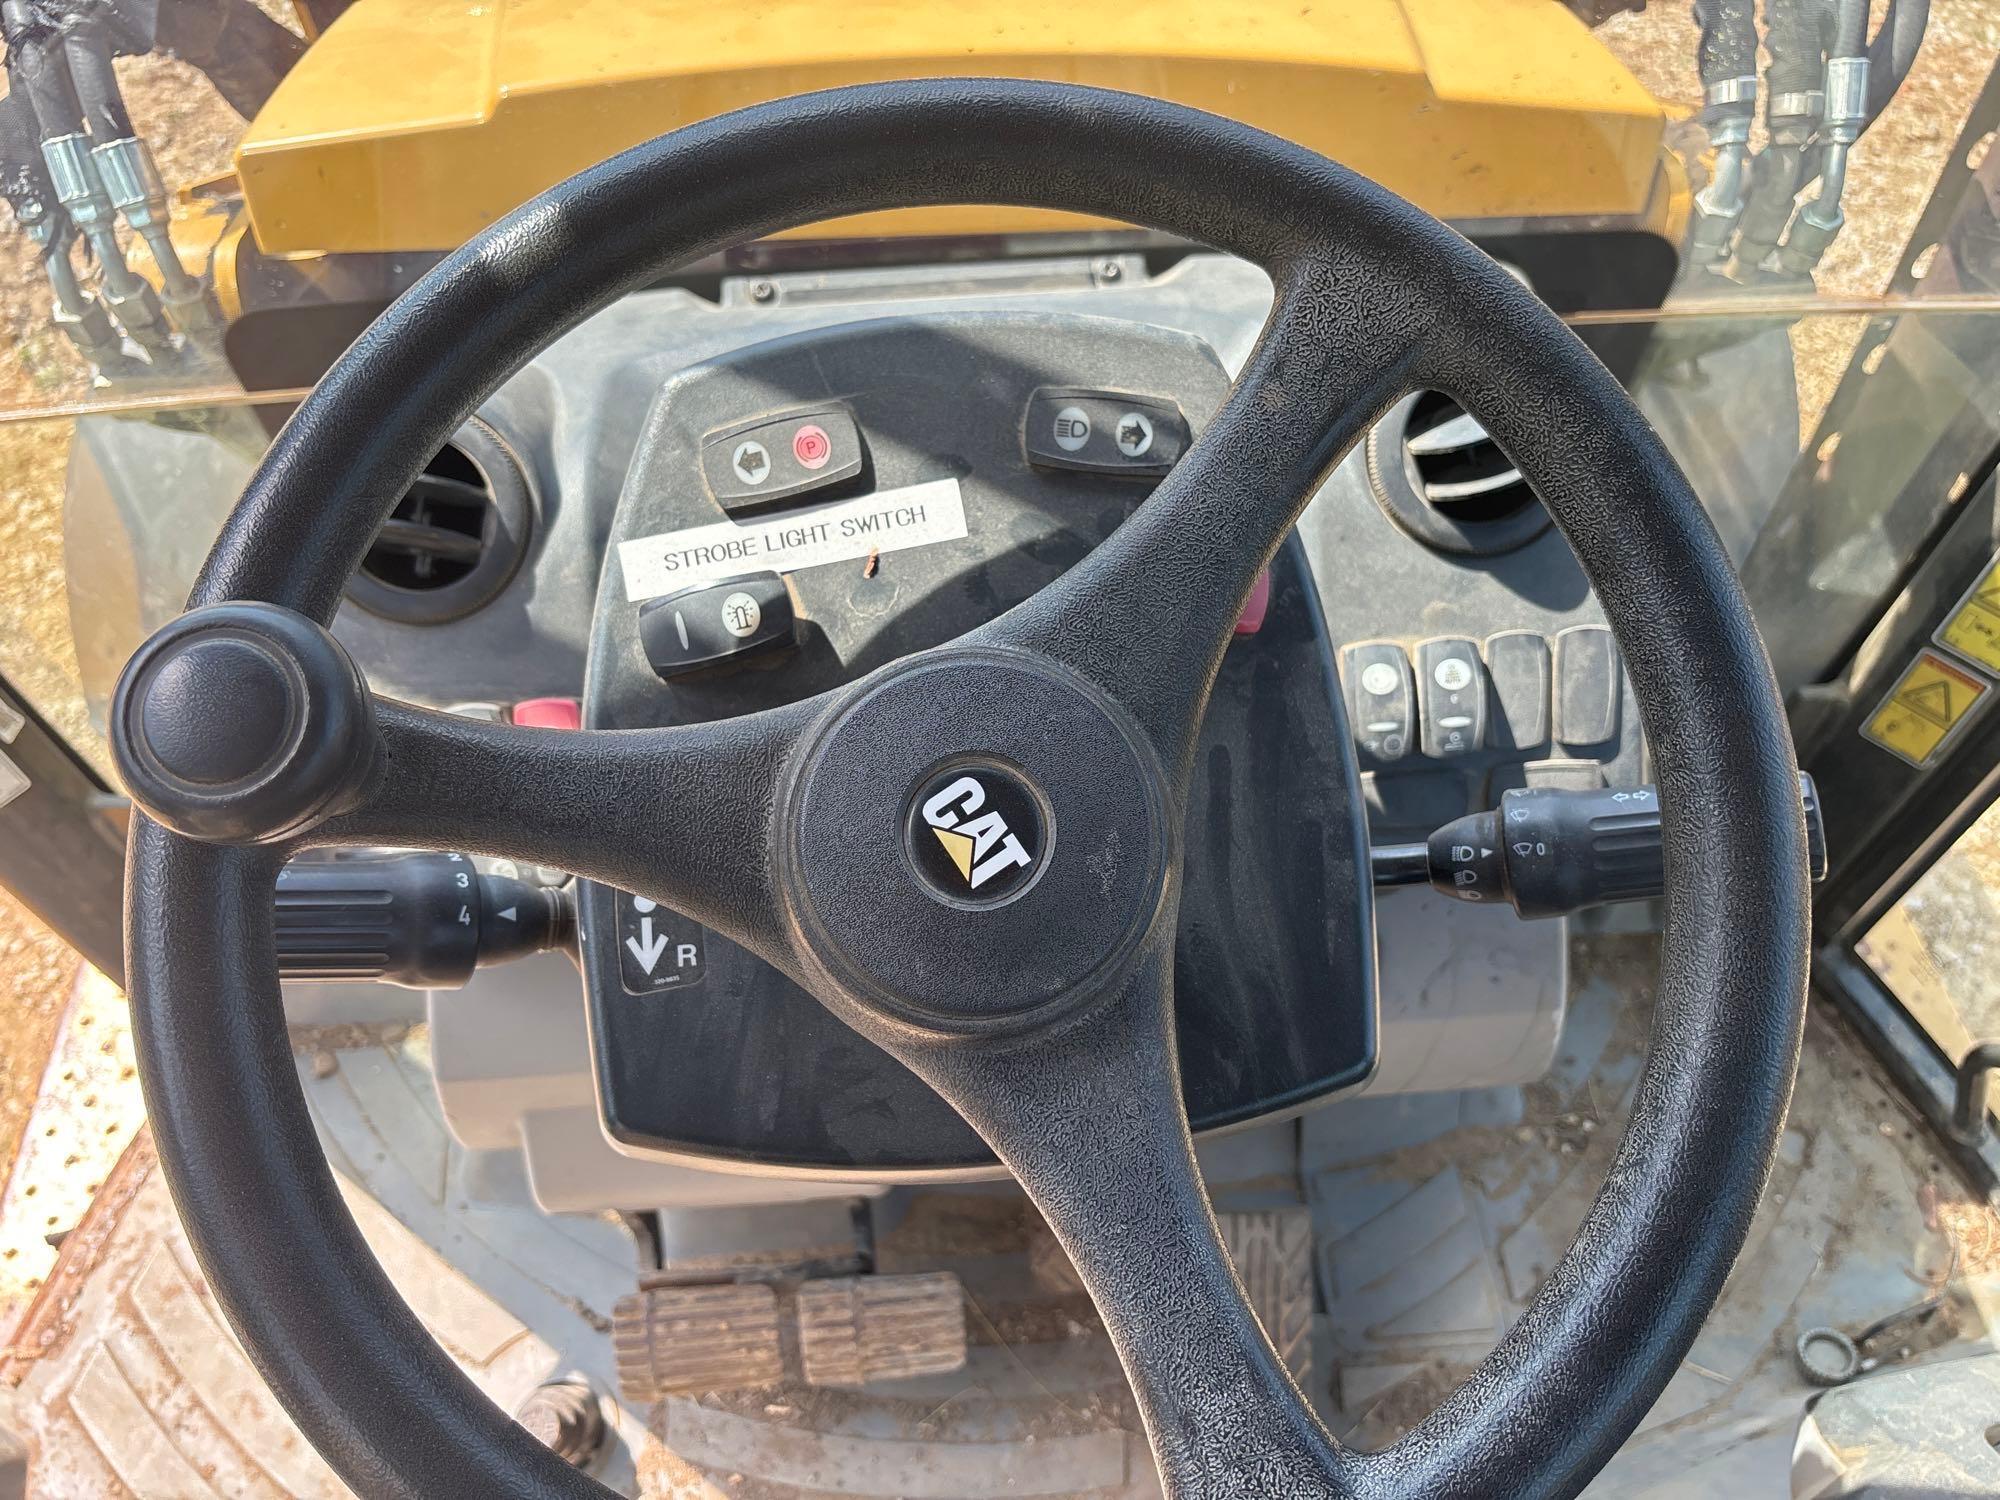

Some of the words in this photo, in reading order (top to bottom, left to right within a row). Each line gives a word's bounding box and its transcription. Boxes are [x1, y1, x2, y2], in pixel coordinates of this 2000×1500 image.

[806, 441, 816, 455] P
[663, 536, 758, 572] STROBE
[764, 523, 832, 553] LIGHT
[840, 504, 927, 538] SWITCH
[922, 776, 1032, 890] CAT
[455, 872, 469, 888] 3
[459, 904, 471, 926] 4
[677, 943, 697, 967] R
